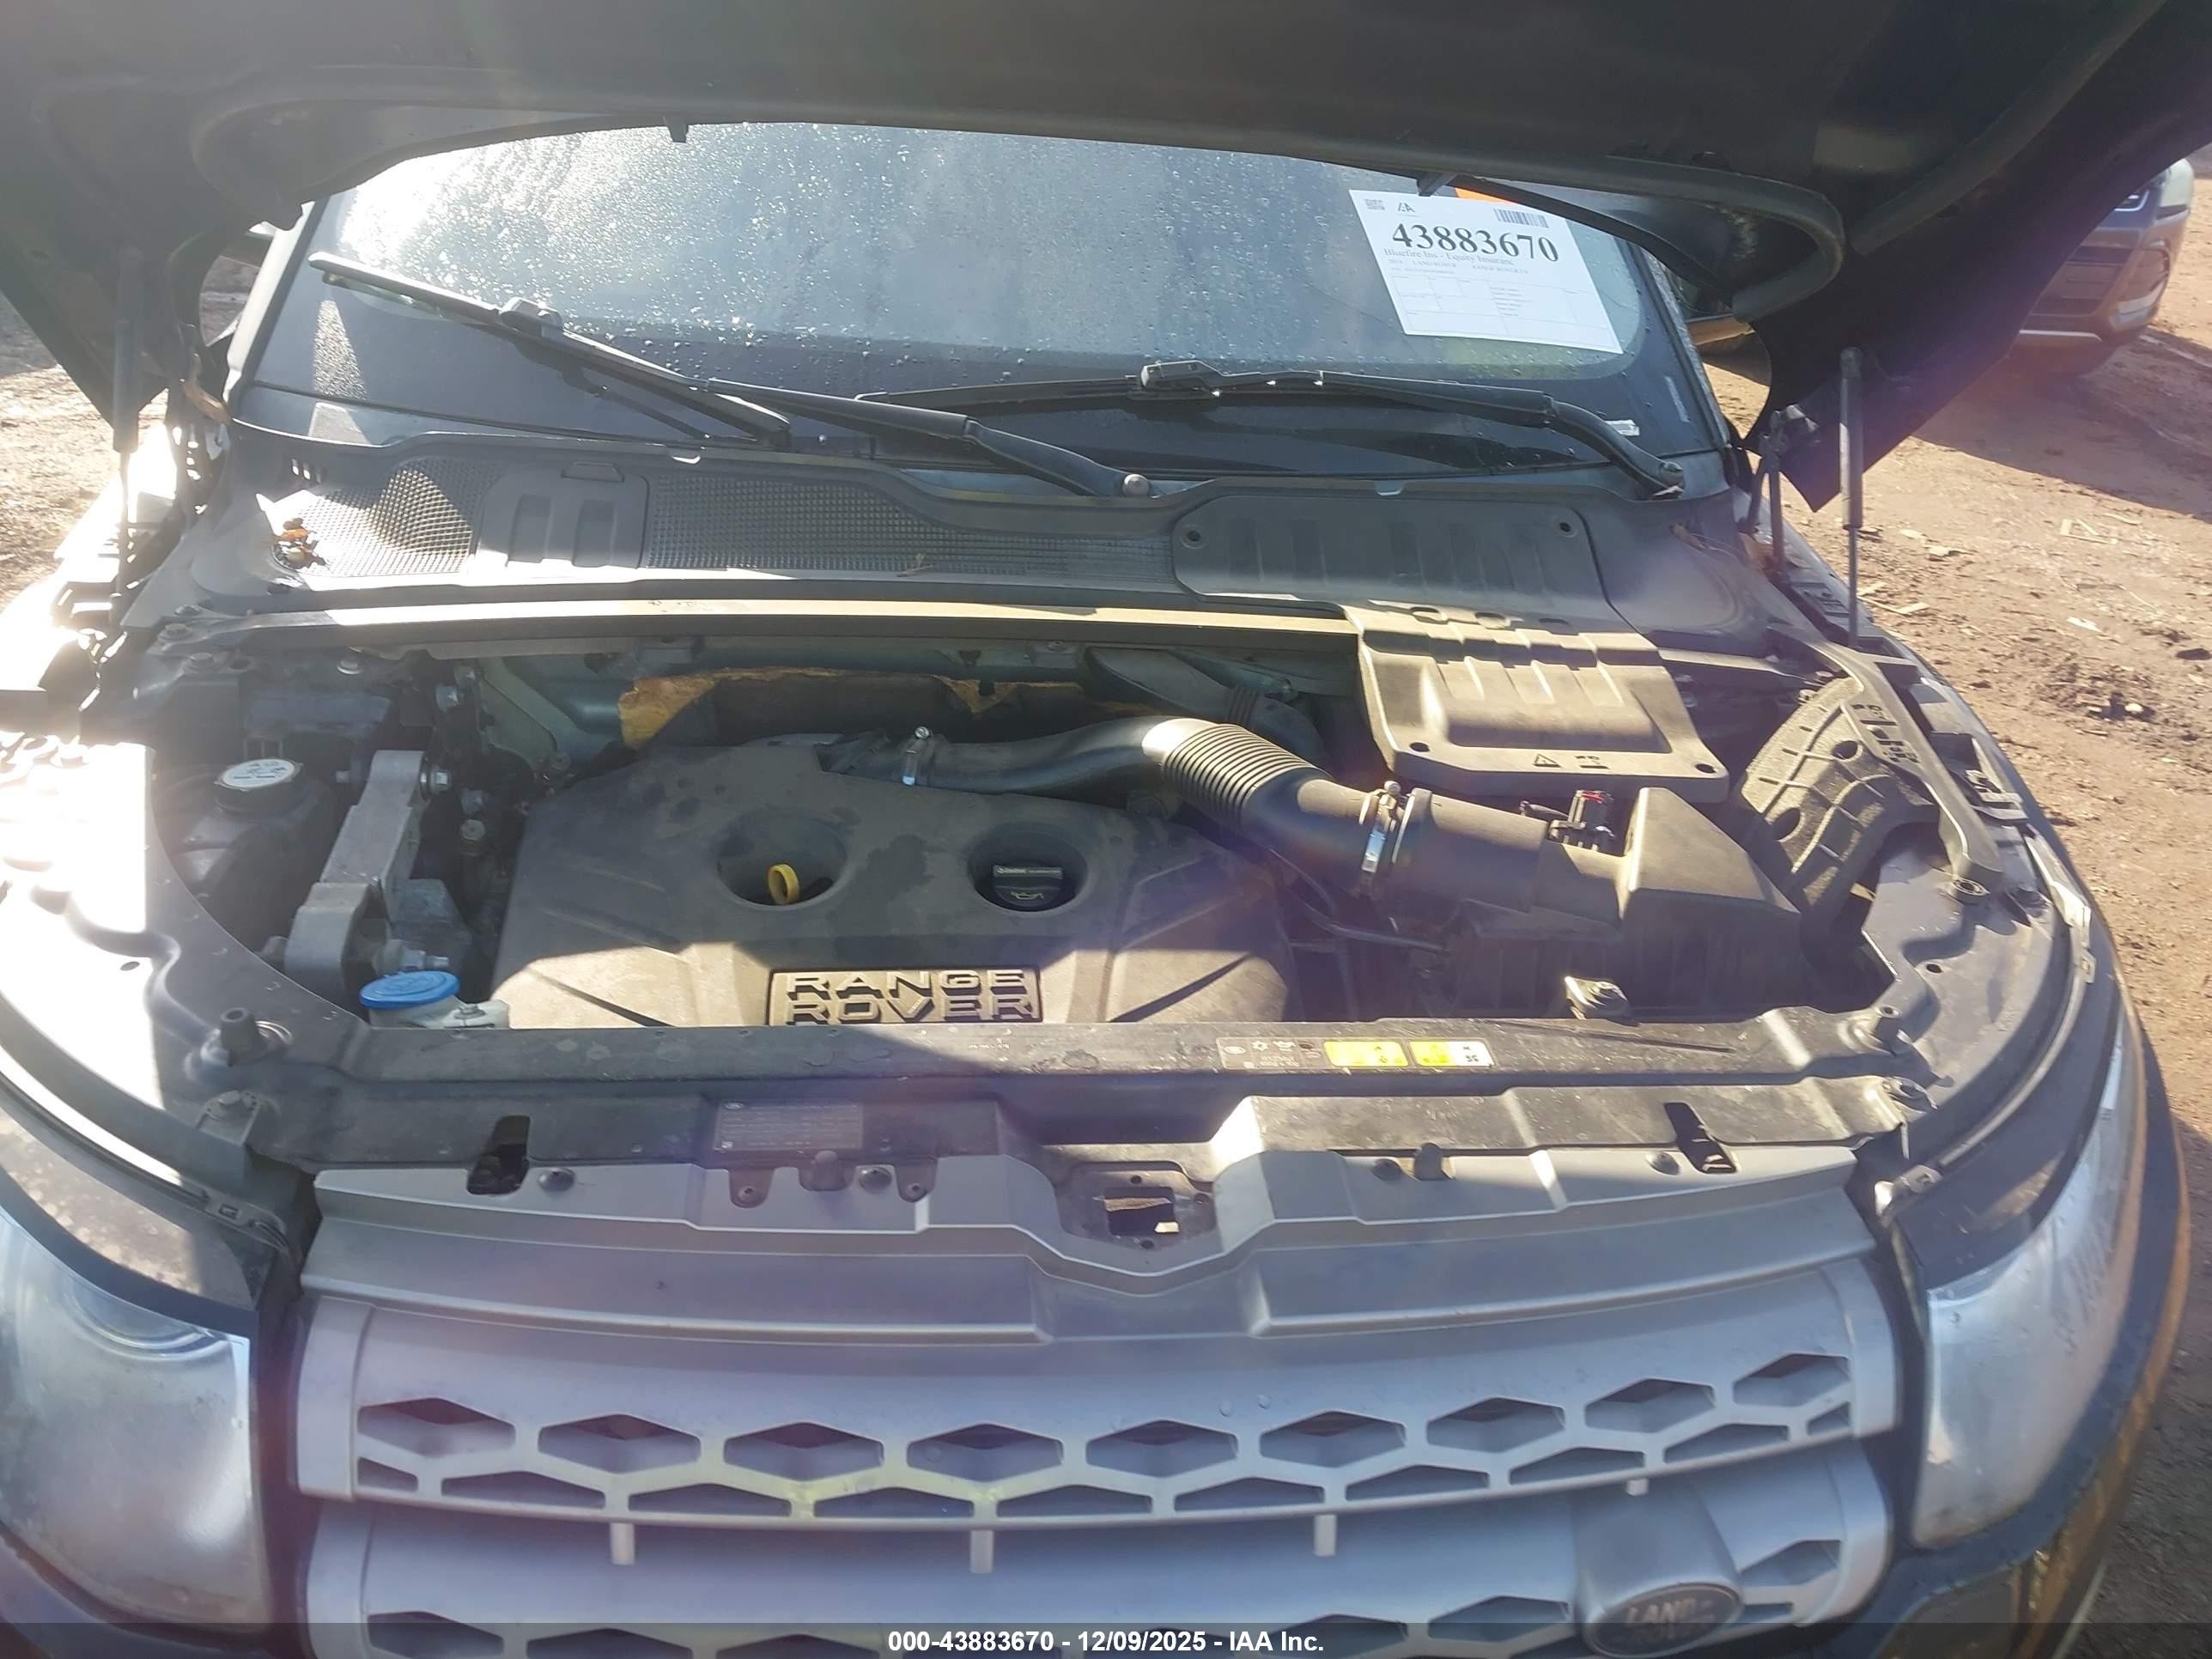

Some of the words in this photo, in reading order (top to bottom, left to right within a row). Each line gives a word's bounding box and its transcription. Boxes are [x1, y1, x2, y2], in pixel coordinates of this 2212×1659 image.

[1392, 223, 1559, 262] 43883670
[786, 969, 1025, 996] RANGE
[786, 994, 1038, 1025] ROVER
